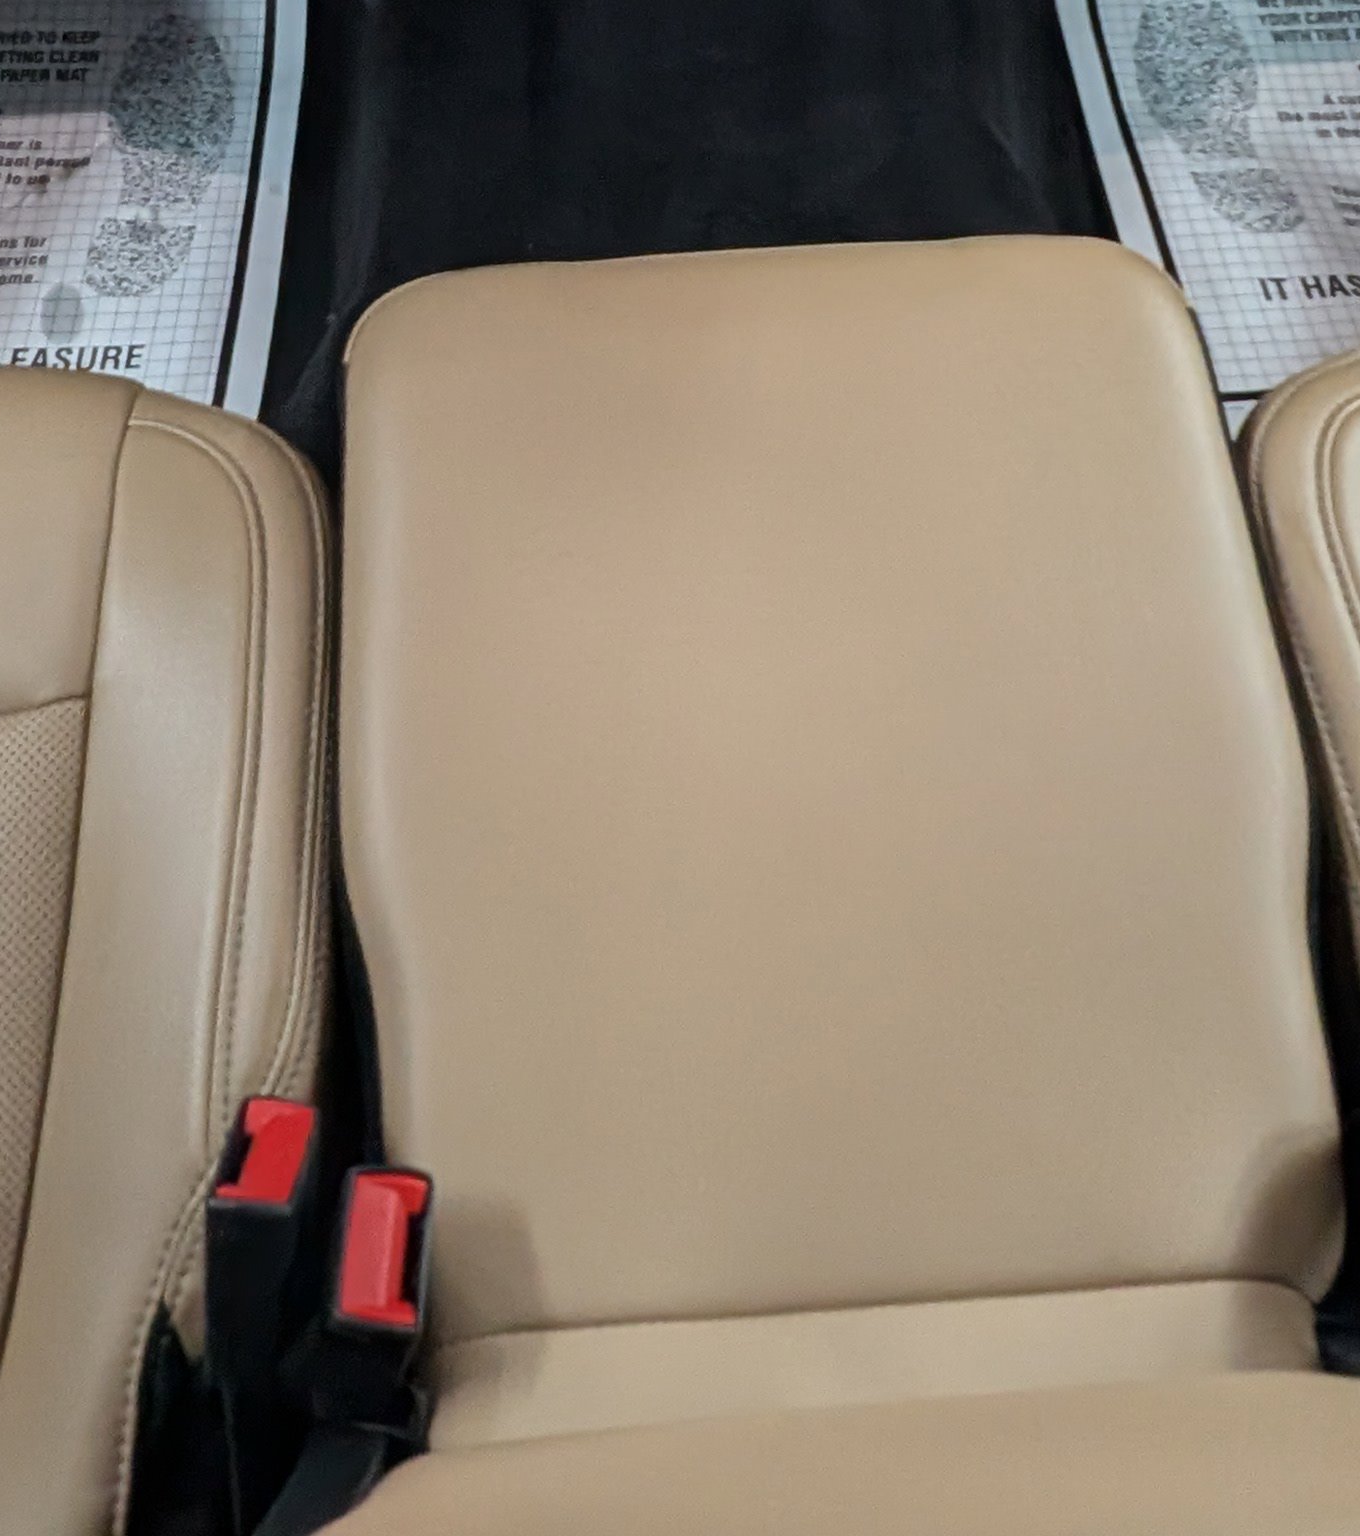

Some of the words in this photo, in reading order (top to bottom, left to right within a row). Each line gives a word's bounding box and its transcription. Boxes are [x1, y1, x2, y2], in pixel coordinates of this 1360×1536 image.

[1258, 12, 1302, 26] YOUR
[37, 31, 57, 44] TO
[62, 30, 101, 44] KEEP
[1271, 29, 1312, 43] WITH
[1315, 28, 1351, 41] THIS
[49, 50, 100, 63] CLEAN
[0, 68, 50, 82] PAPER
[55, 68, 90, 82] MAT
[1324, 94, 1335, 105] A
[1277, 111, 1305, 122] the
[1307, 111, 1347, 121] most
[1316, 128, 1332, 138] in
[29, 139, 43, 151] is
[33, 156, 91, 171] person
[5, 173, 22, 185] to
[23, 236, 47, 249] for
[1257, 277, 1289, 301] IT
